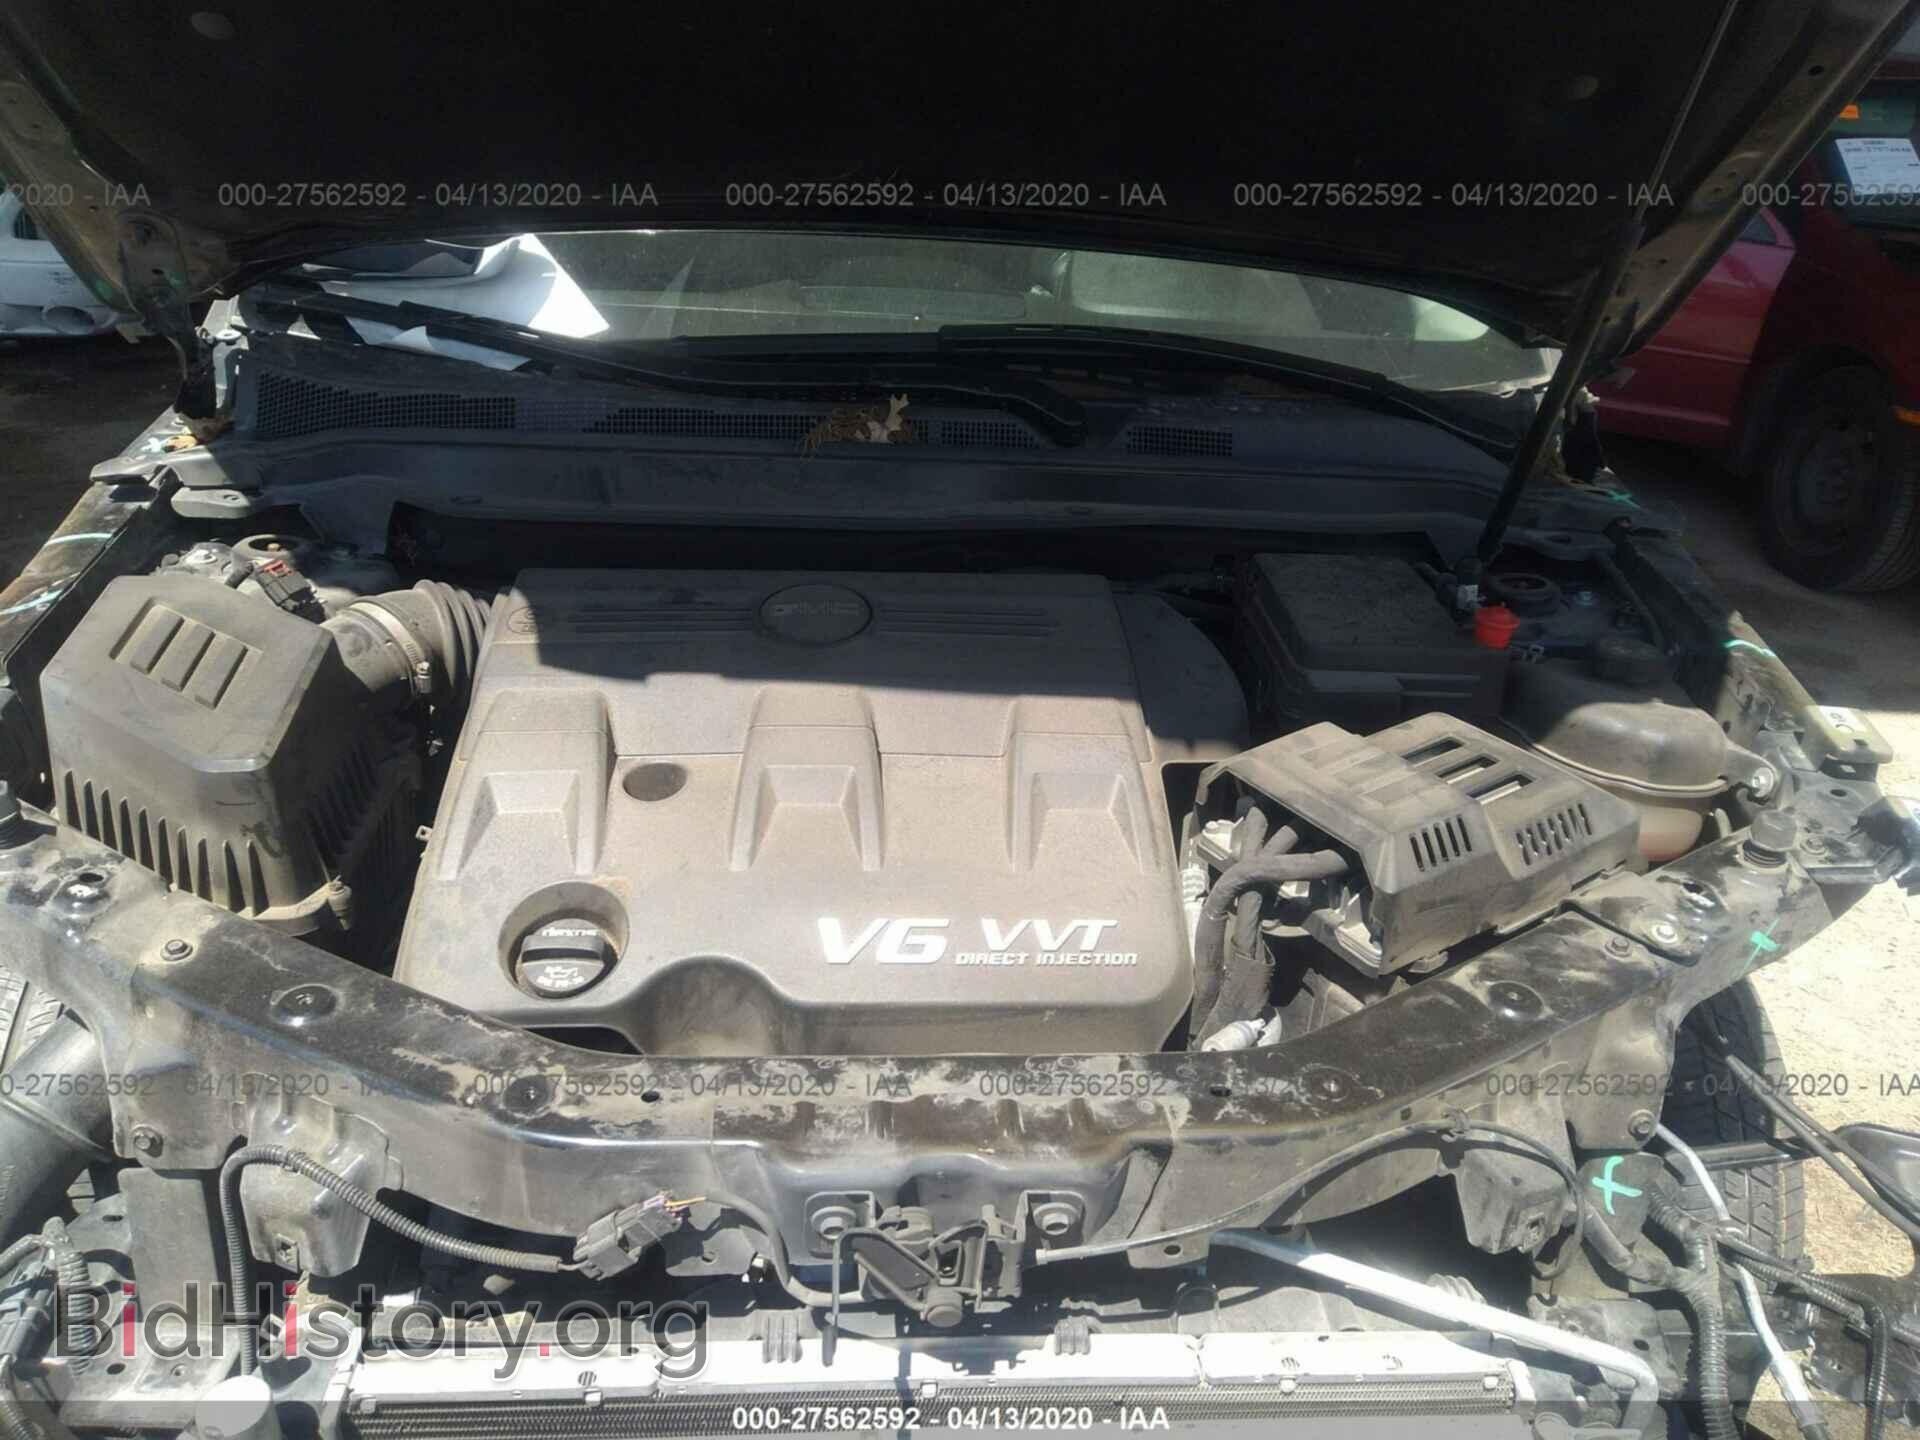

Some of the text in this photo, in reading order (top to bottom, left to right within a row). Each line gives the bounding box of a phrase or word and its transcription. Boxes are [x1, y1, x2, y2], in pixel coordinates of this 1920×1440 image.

[817, 917, 1119, 965] V6 VVT
[955, 953, 1138, 965] DIRECT INJECTION
